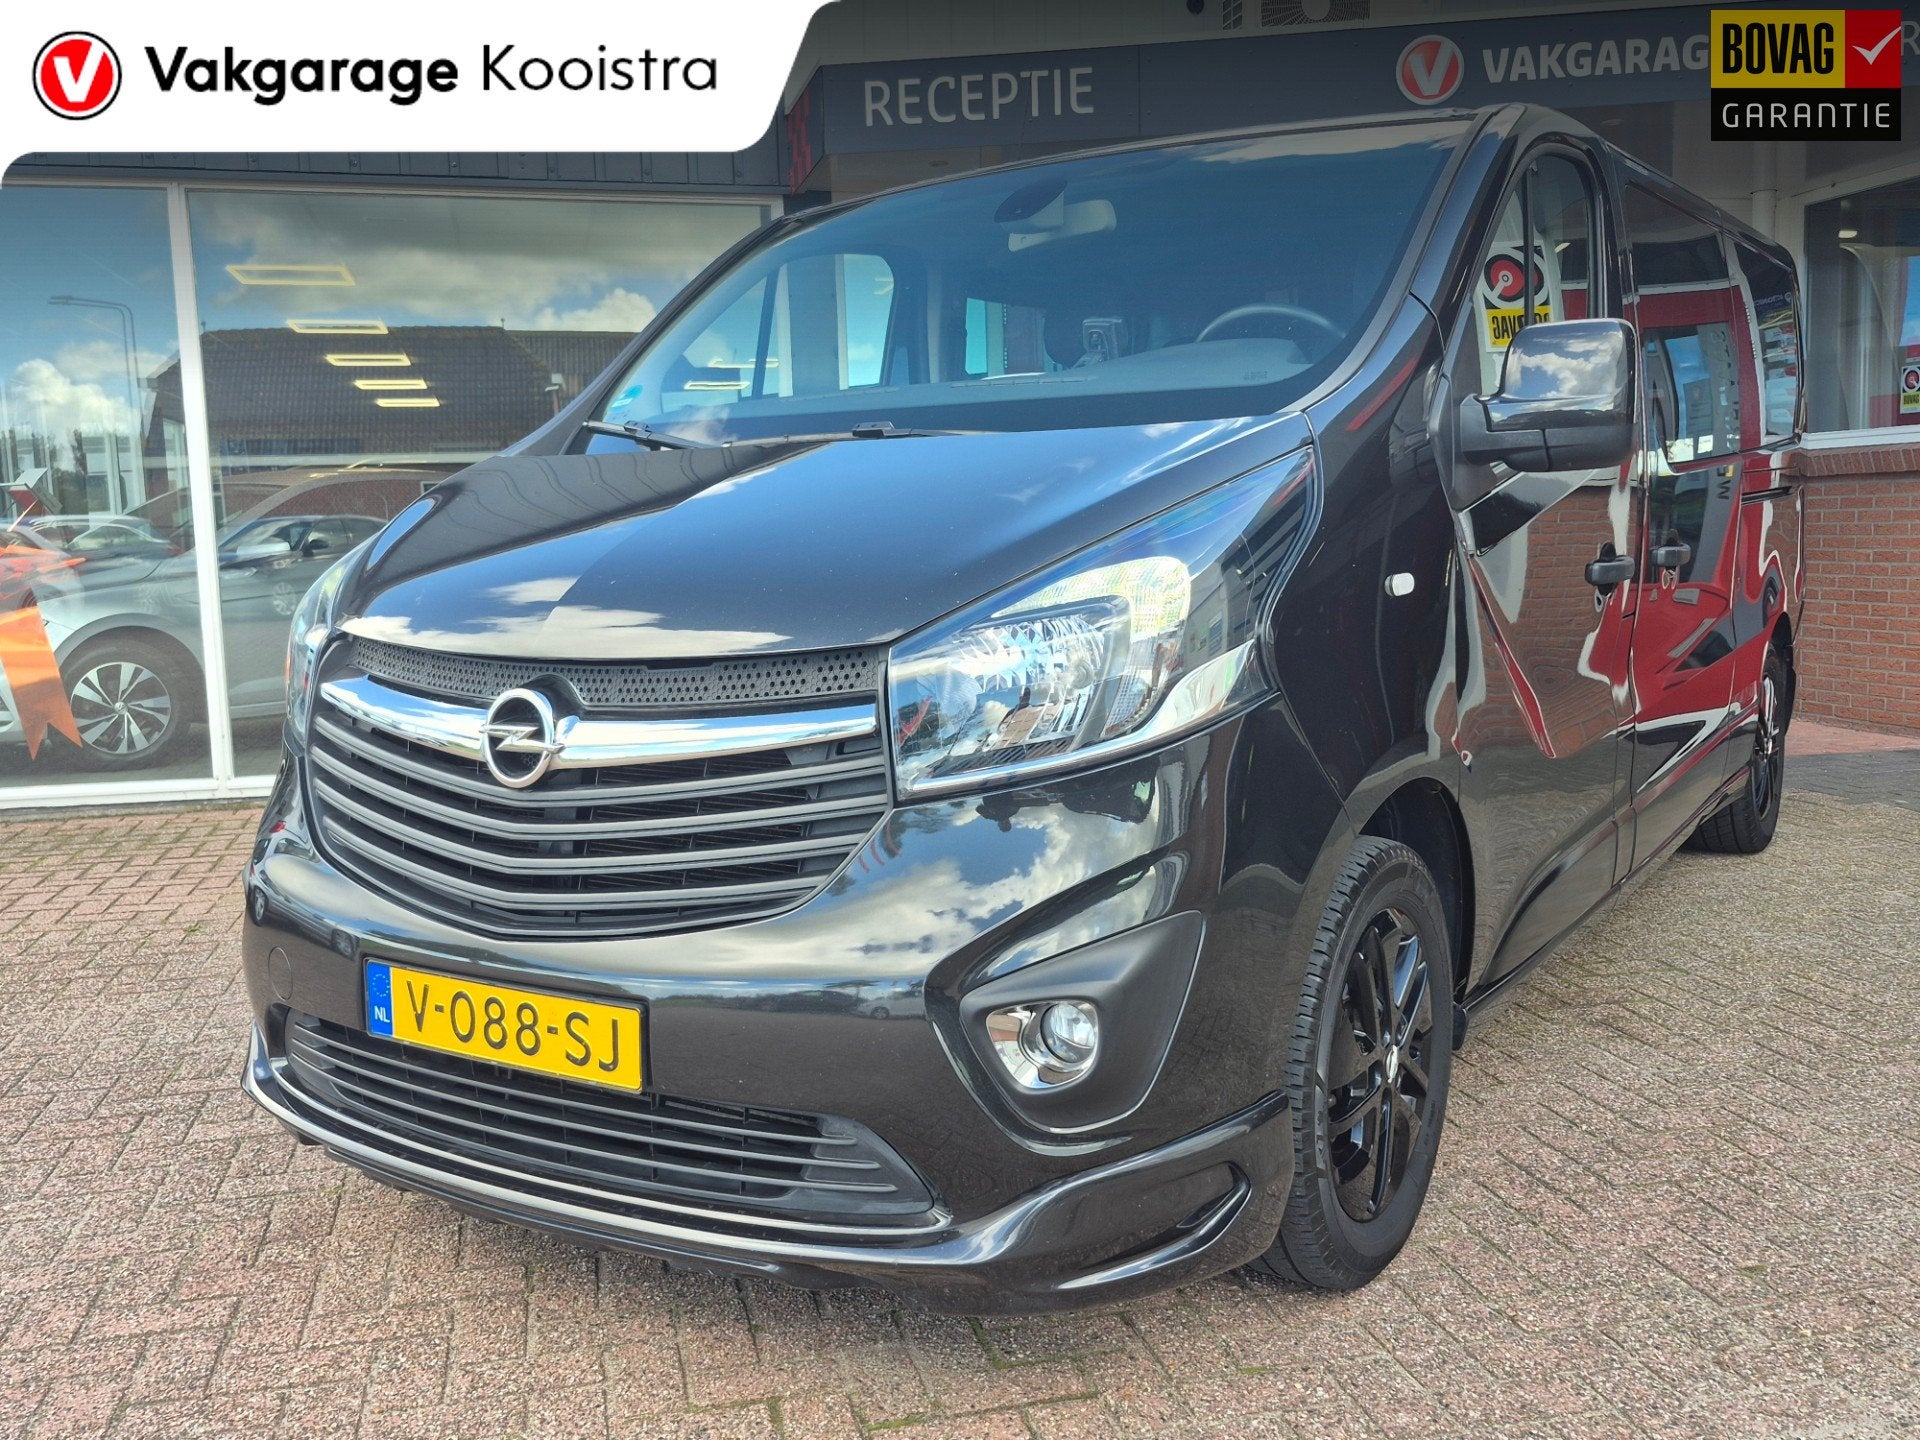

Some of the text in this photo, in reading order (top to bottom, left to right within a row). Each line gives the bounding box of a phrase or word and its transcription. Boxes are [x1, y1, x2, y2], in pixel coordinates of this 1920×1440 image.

[1482, 34, 1710, 84] VAKGARAG
[864, 66, 1095, 127] RECEPTIE
[374, 1005, 391, 1023] NL
[406, 980, 619, 1073] V-088-SJ
